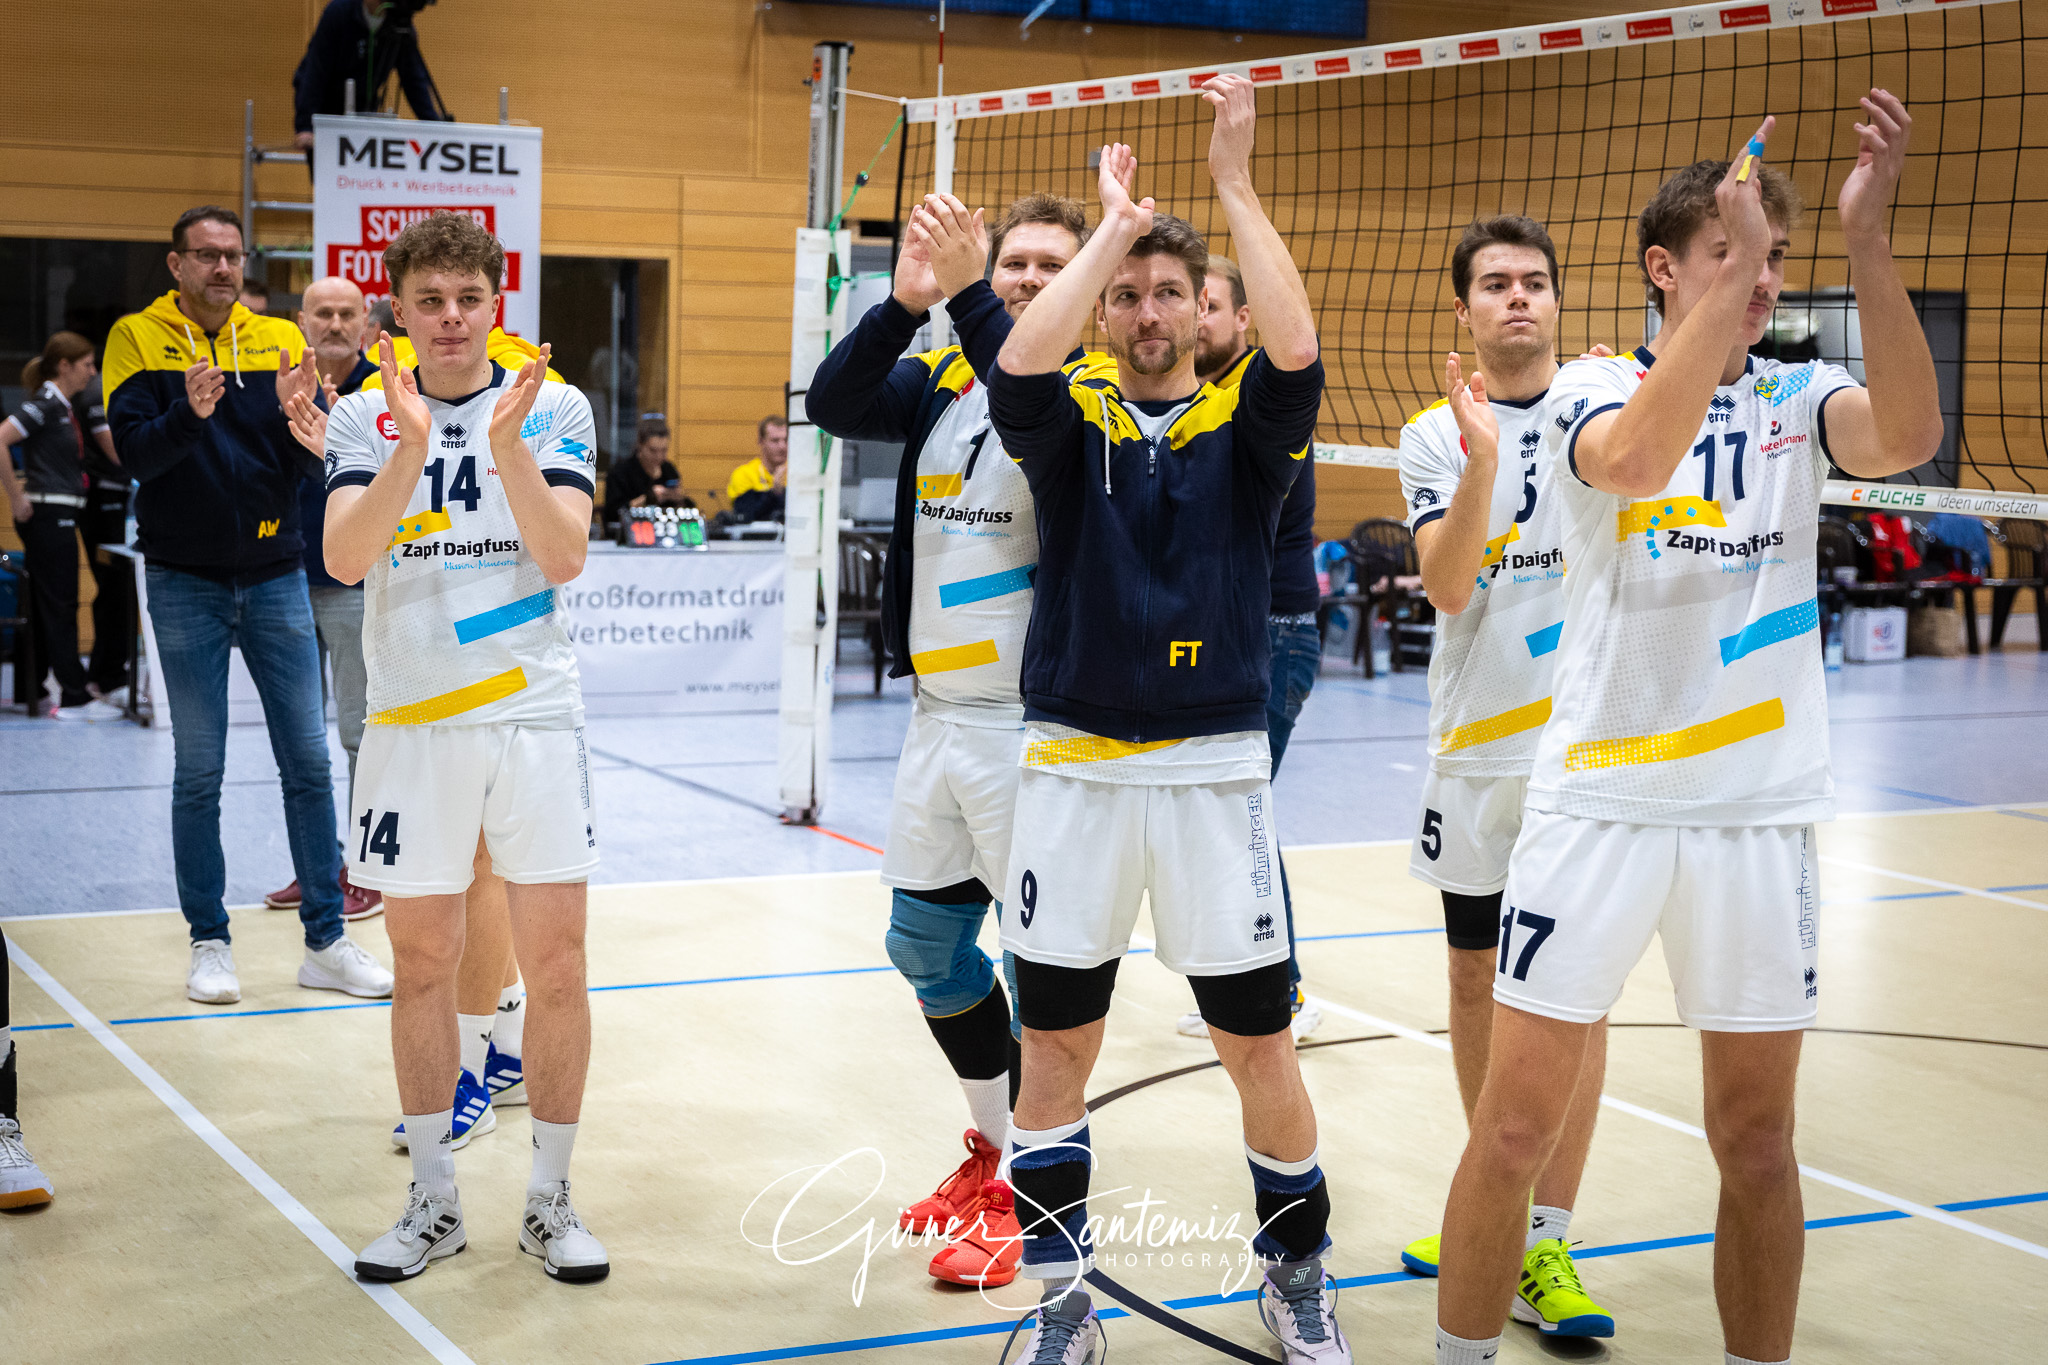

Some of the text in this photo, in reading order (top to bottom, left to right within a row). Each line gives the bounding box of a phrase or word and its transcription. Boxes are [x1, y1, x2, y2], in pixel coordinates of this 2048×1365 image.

[338, 136, 520, 176] MEYSEL
[336, 174, 517, 197] Druck Werbetechnik
[440, 439, 467, 449] errea
[1692, 430, 1748, 502] 17
[423, 455, 482, 514] 14
[1514, 462, 1538, 524] 5
[920, 500, 1013, 525] Zapf Daigfuss
[1867, 489, 2039, 515] FUCHS Ideen umsetzen
[257, 518, 281, 539] AW
[1666, 529, 1717, 555] Zapf
[402, 538, 520, 560] Zapf Daigfuss
[1169, 640, 1203, 667] FT
[359, 808, 400, 866] 14
[1420, 807, 1443, 862] 5
[1020, 868, 1038, 930] 9
[1253, 929, 1275, 943] errea
[1498, 905, 1556, 982] 17
